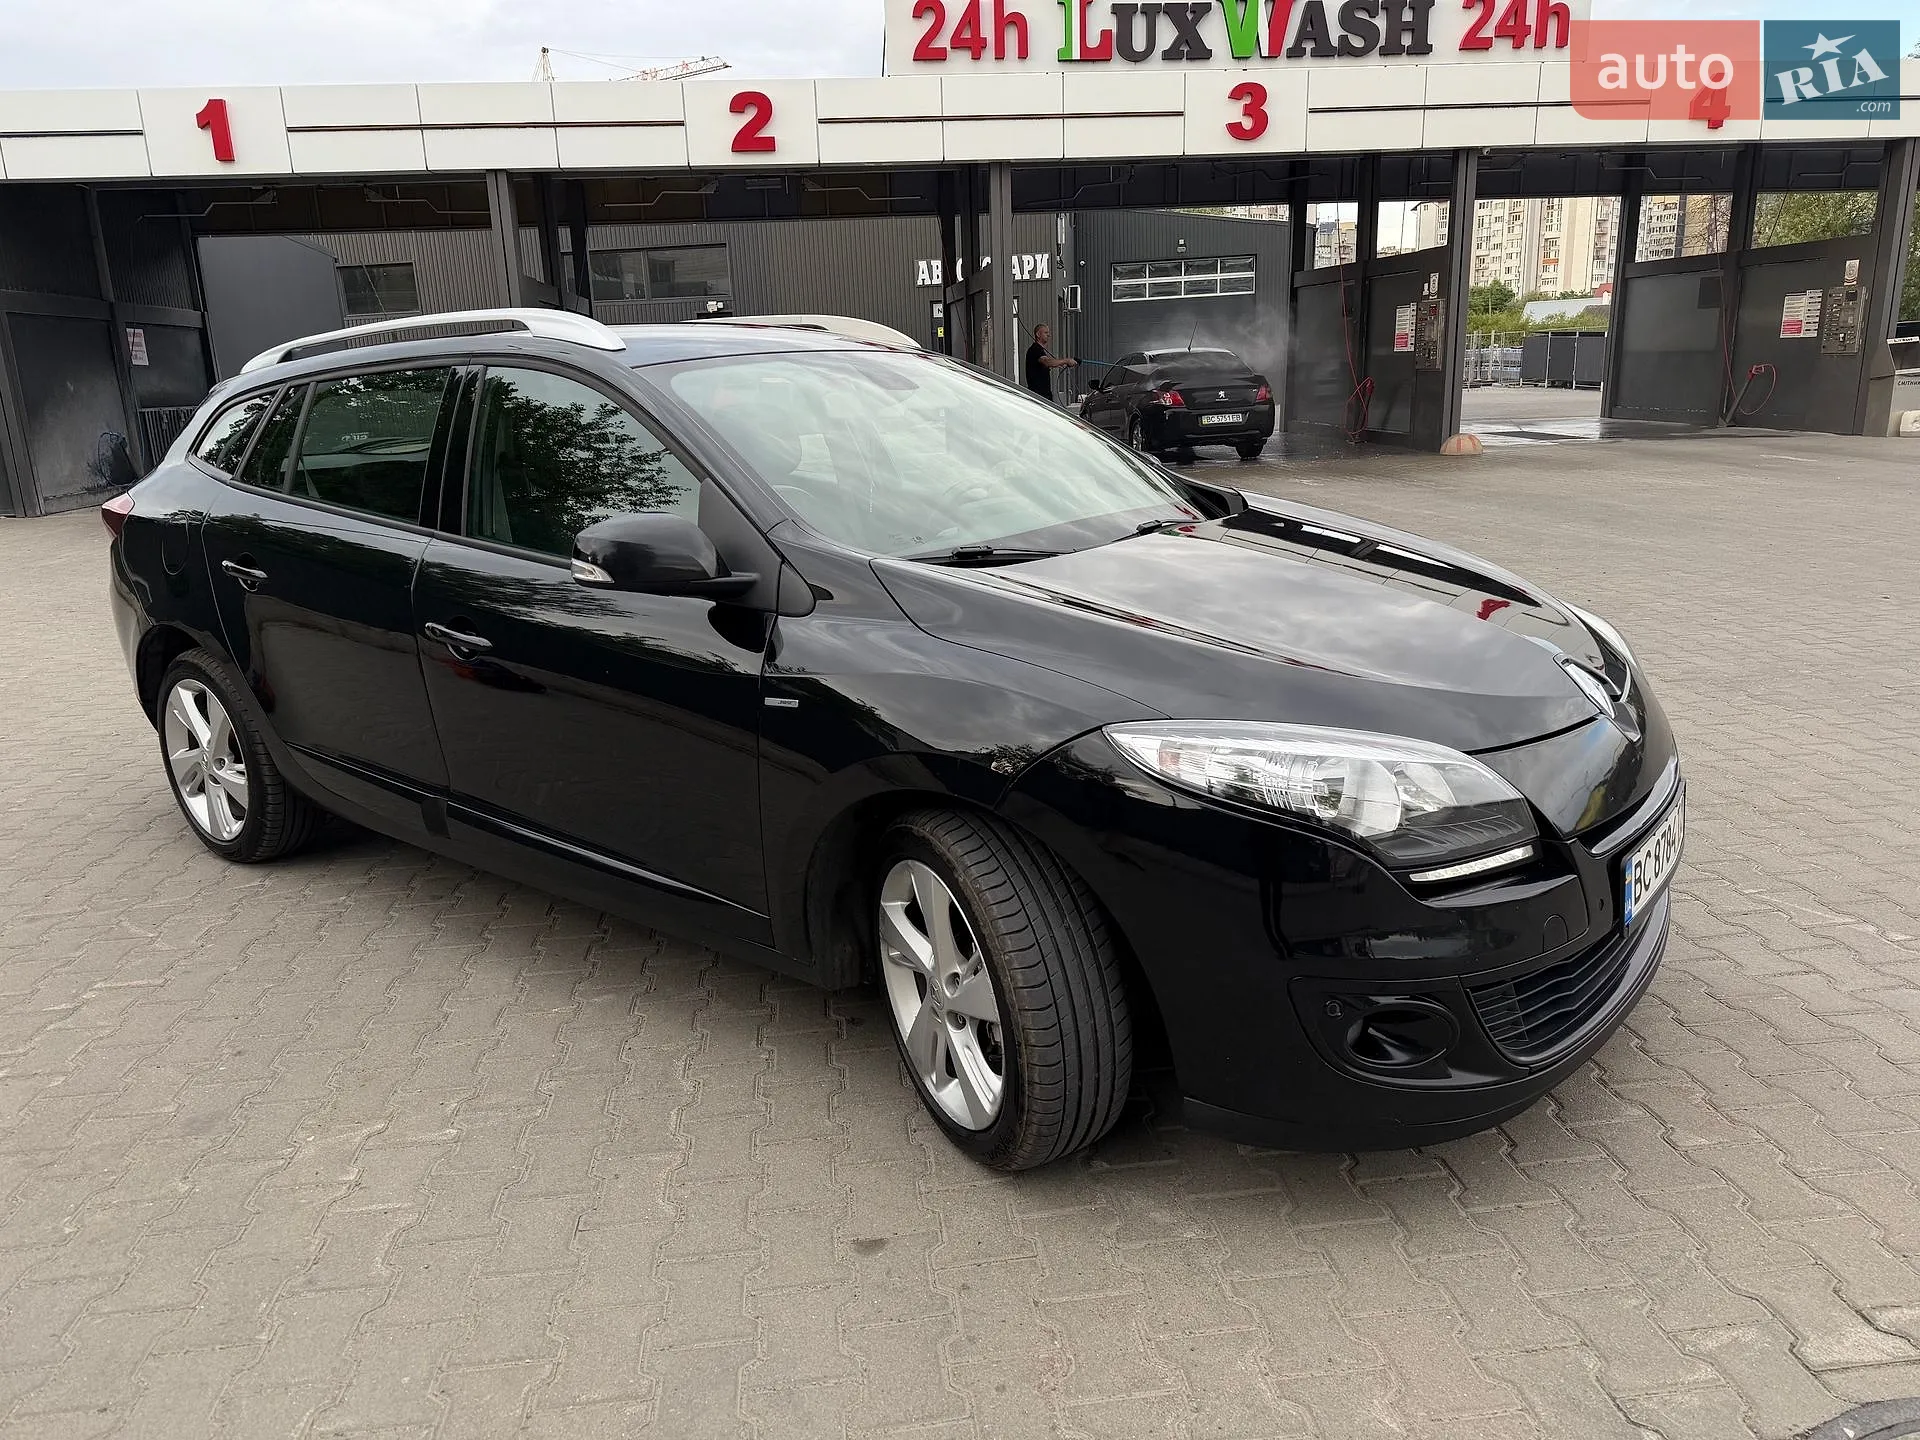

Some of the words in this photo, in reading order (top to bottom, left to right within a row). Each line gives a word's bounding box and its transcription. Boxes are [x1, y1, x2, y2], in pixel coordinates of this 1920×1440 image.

[912, 0, 1028, 61] 24h
[1459, 0, 1571, 50] 24h
[196, 99, 235, 162] 1
[729, 91, 776, 152] 2
[1226, 82, 1269, 141] 3
[1634, 849, 1652, 906] BC
